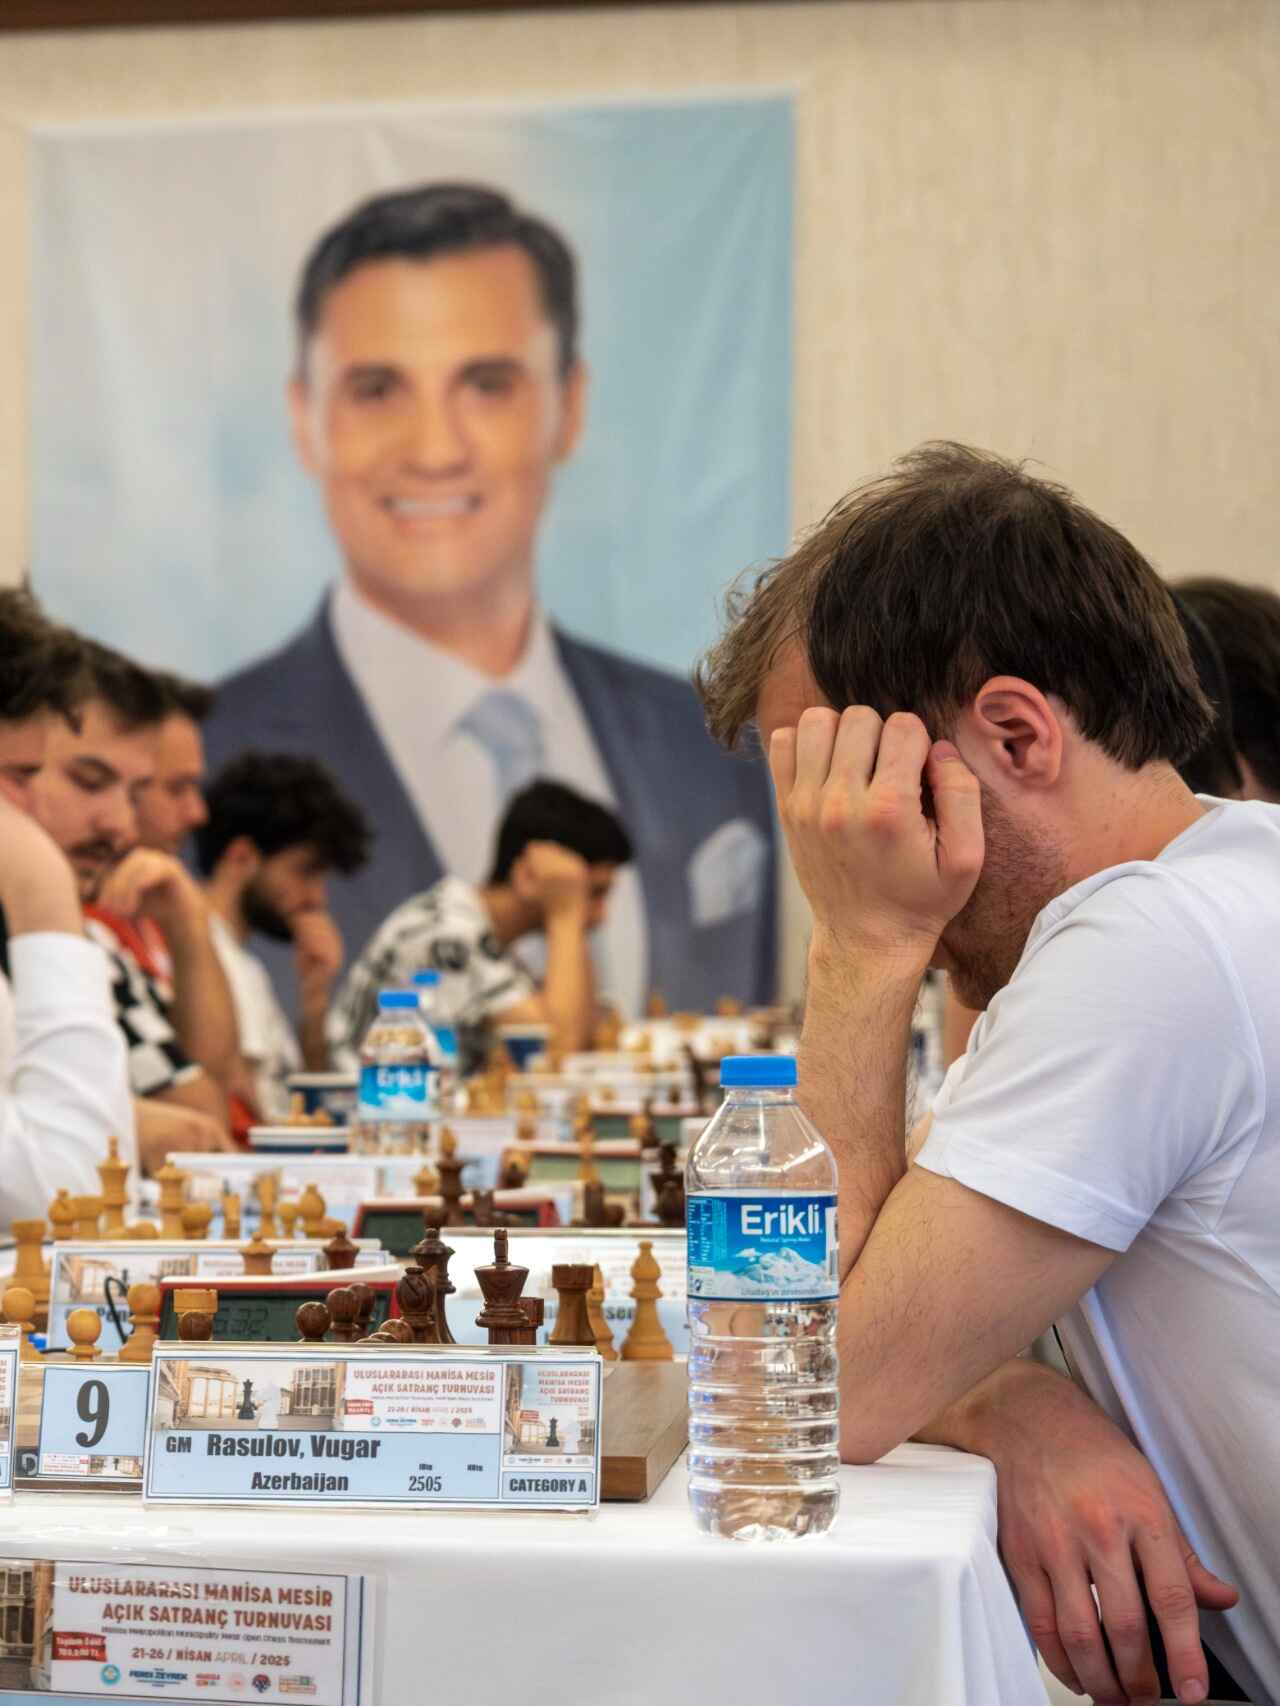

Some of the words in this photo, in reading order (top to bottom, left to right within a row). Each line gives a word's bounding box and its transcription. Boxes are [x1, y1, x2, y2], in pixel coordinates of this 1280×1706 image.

[741, 1204, 819, 1235] Erikli
[76, 1380, 110, 1448] 9
[166, 1436, 192, 1453] GM
[207, 1434, 305, 1460] Rasulov,
[310, 1435, 381, 1460] Vugar
[251, 1471, 349, 1492] Azerbaijan
[408, 1475, 442, 1492] 2505
[509, 1478, 576, 1493] CATEGORY
[577, 1478, 587, 1493] A
[68, 1576, 199, 1600] ULUSLARARASI
[204, 1581, 273, 1604] MANİSA
[278, 1585, 333, 1607] MESİR
[102, 1603, 146, 1624] AÇIK
[149, 1607, 228, 1629] SATRANÇ
[233, 1610, 332, 1632] TURNUVASI
[132, 1647, 164, 1660] 21-26
[176, 1647, 212, 1662] NİSAN
[259, 1653, 291, 1666] 2025
